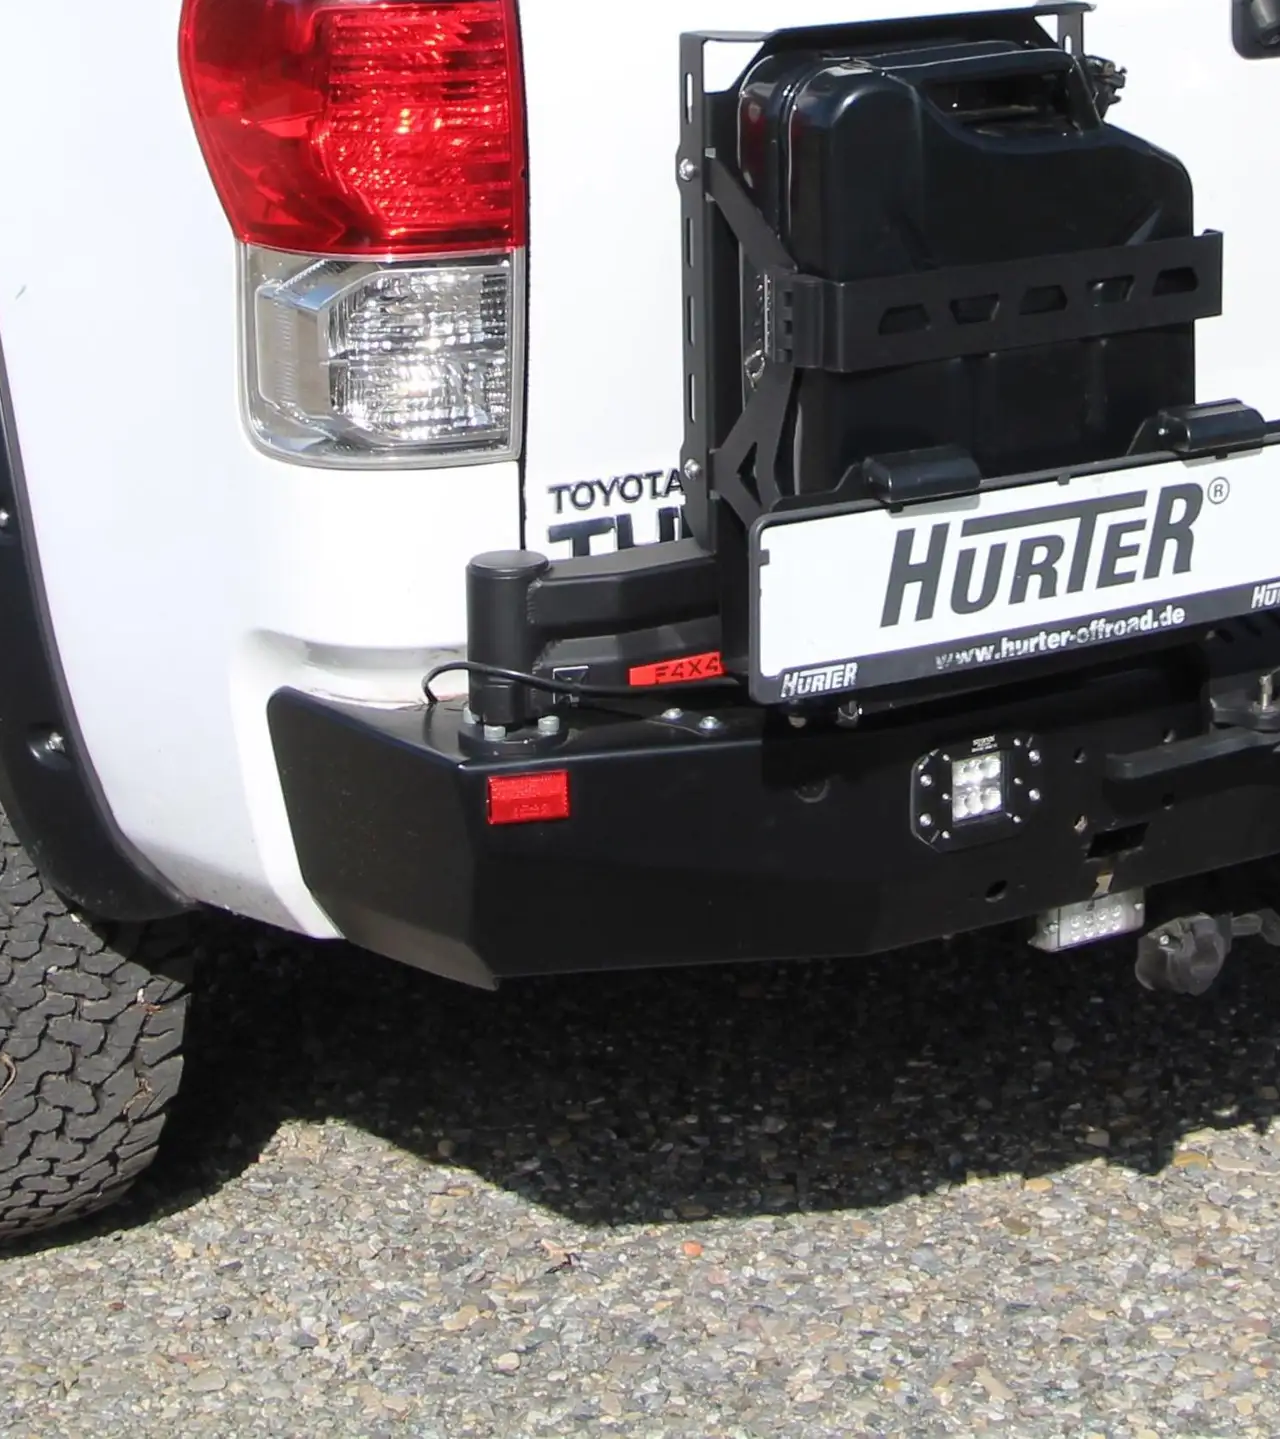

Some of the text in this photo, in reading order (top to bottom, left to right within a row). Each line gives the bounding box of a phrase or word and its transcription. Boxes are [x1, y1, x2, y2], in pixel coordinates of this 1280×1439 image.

[547, 468, 684, 514] TOYOTA
[880, 482, 1203, 628] HURTER
[935, 605, 1185, 670] www.hurter-offroad.de
[780, 662, 857, 698] HURTER
